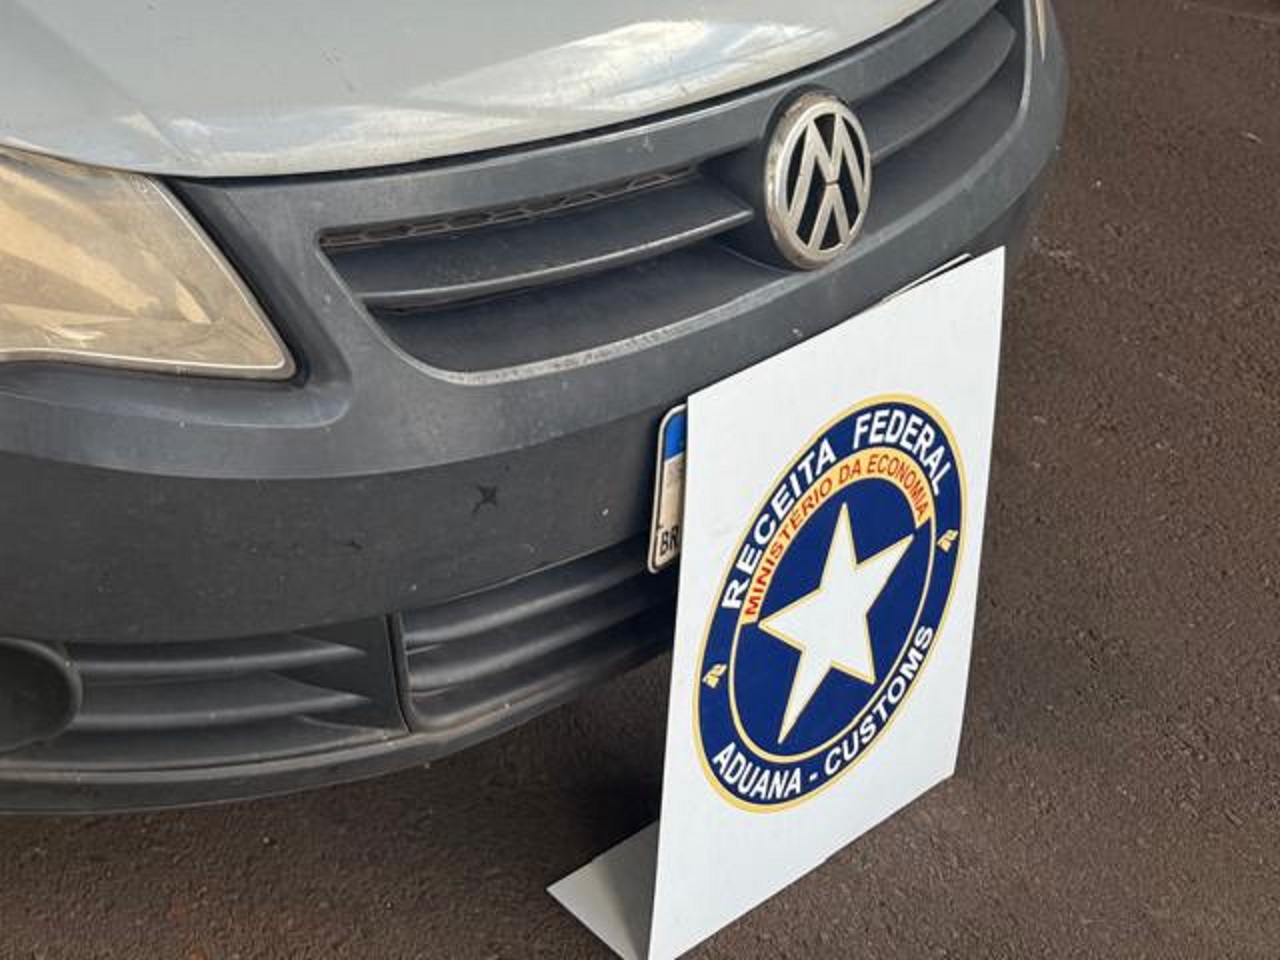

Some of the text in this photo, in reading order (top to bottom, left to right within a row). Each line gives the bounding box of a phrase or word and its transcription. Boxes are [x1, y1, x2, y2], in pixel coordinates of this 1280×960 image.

[660, 525, 679, 556] BR
[722, 409, 951, 610] RECEITA FEDERAL
[745, 453, 929, 616] MINISTERIO DA ECONOMIA
[712, 742, 801, 800] ADUANA
[824, 625, 934, 776] CUSTOMS
